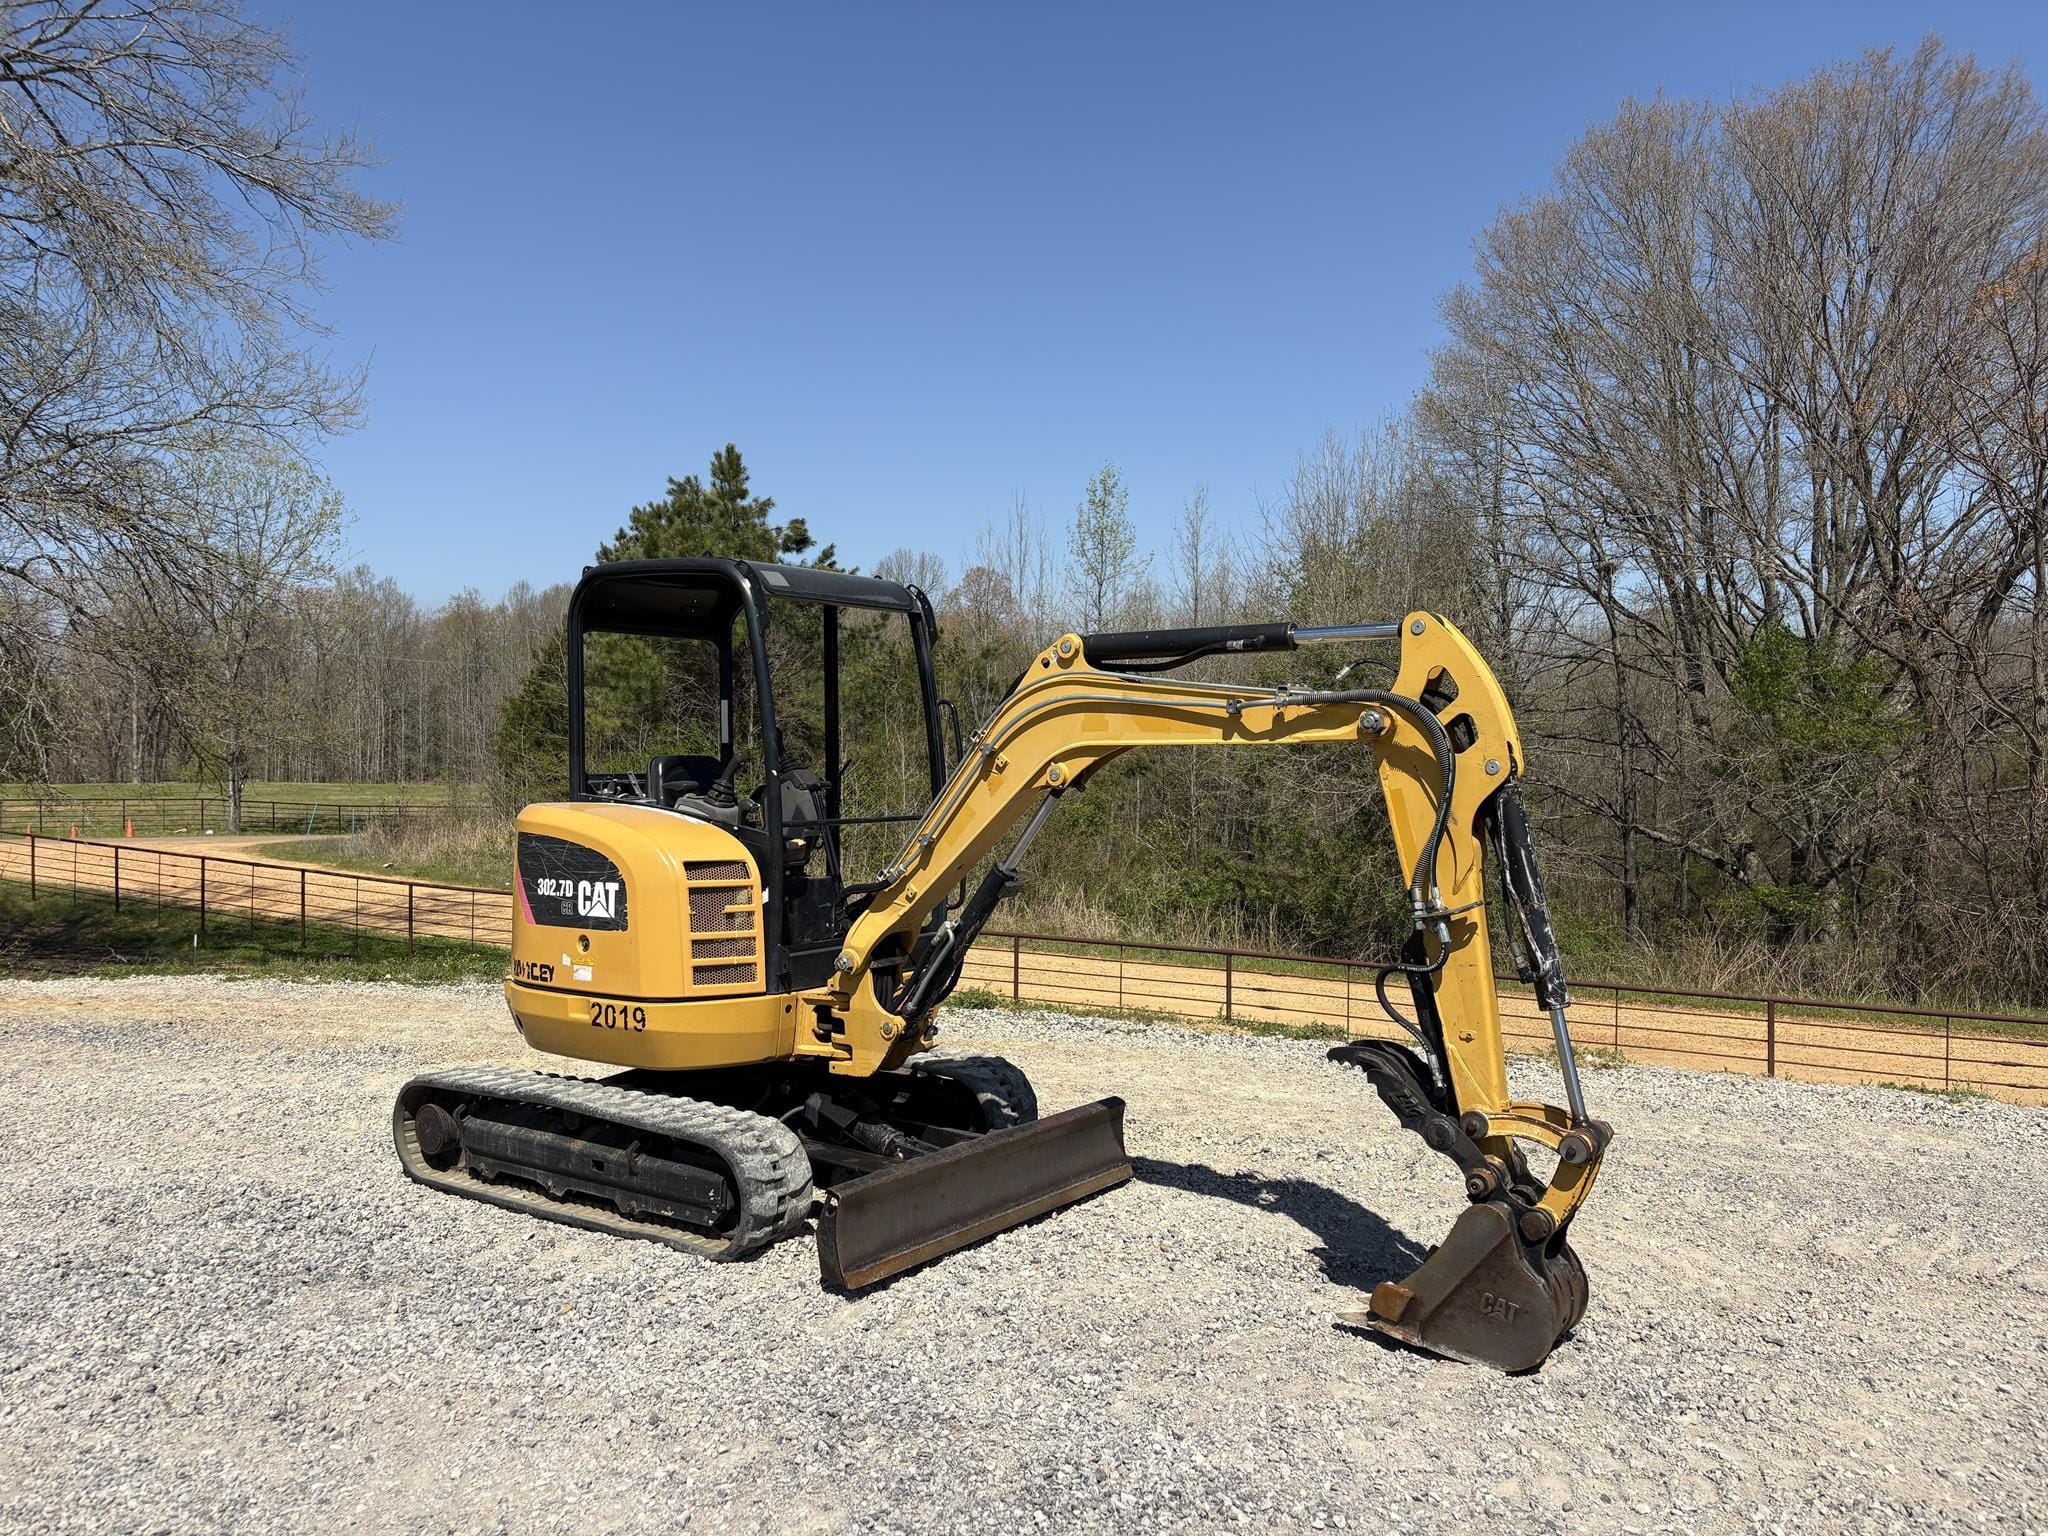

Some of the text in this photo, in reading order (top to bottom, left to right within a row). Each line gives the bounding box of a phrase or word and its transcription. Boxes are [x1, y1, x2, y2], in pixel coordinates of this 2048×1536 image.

[537, 878, 574, 898] 302.7D
[578, 880, 619, 918] CAT
[561, 901, 574, 916] CR
[591, 1001, 646, 1032] 2019
[1480, 1292, 1520, 1325] CAT
